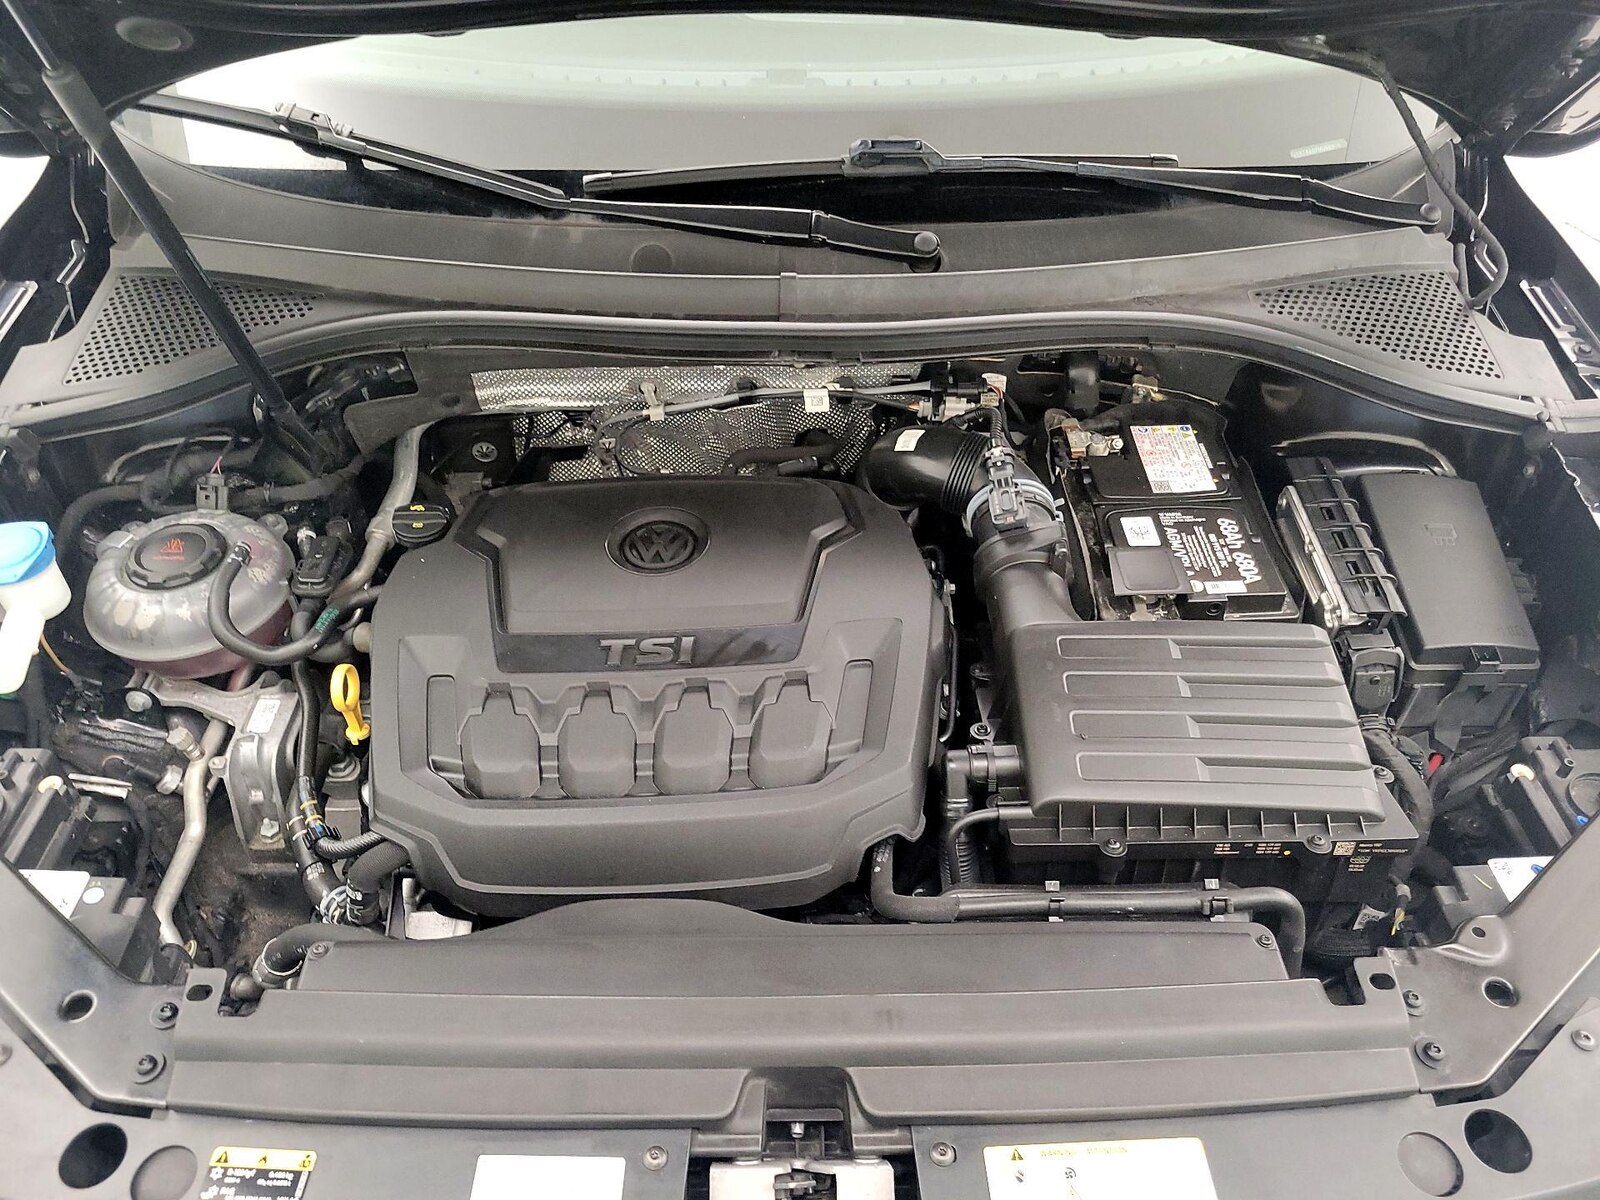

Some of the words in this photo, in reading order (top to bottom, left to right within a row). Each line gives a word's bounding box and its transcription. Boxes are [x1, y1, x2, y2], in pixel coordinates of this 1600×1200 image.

[1217, 517, 1242, 550] 68Ah
[1233, 551, 1262, 584] 680A
[599, 635, 697, 667] TSI
